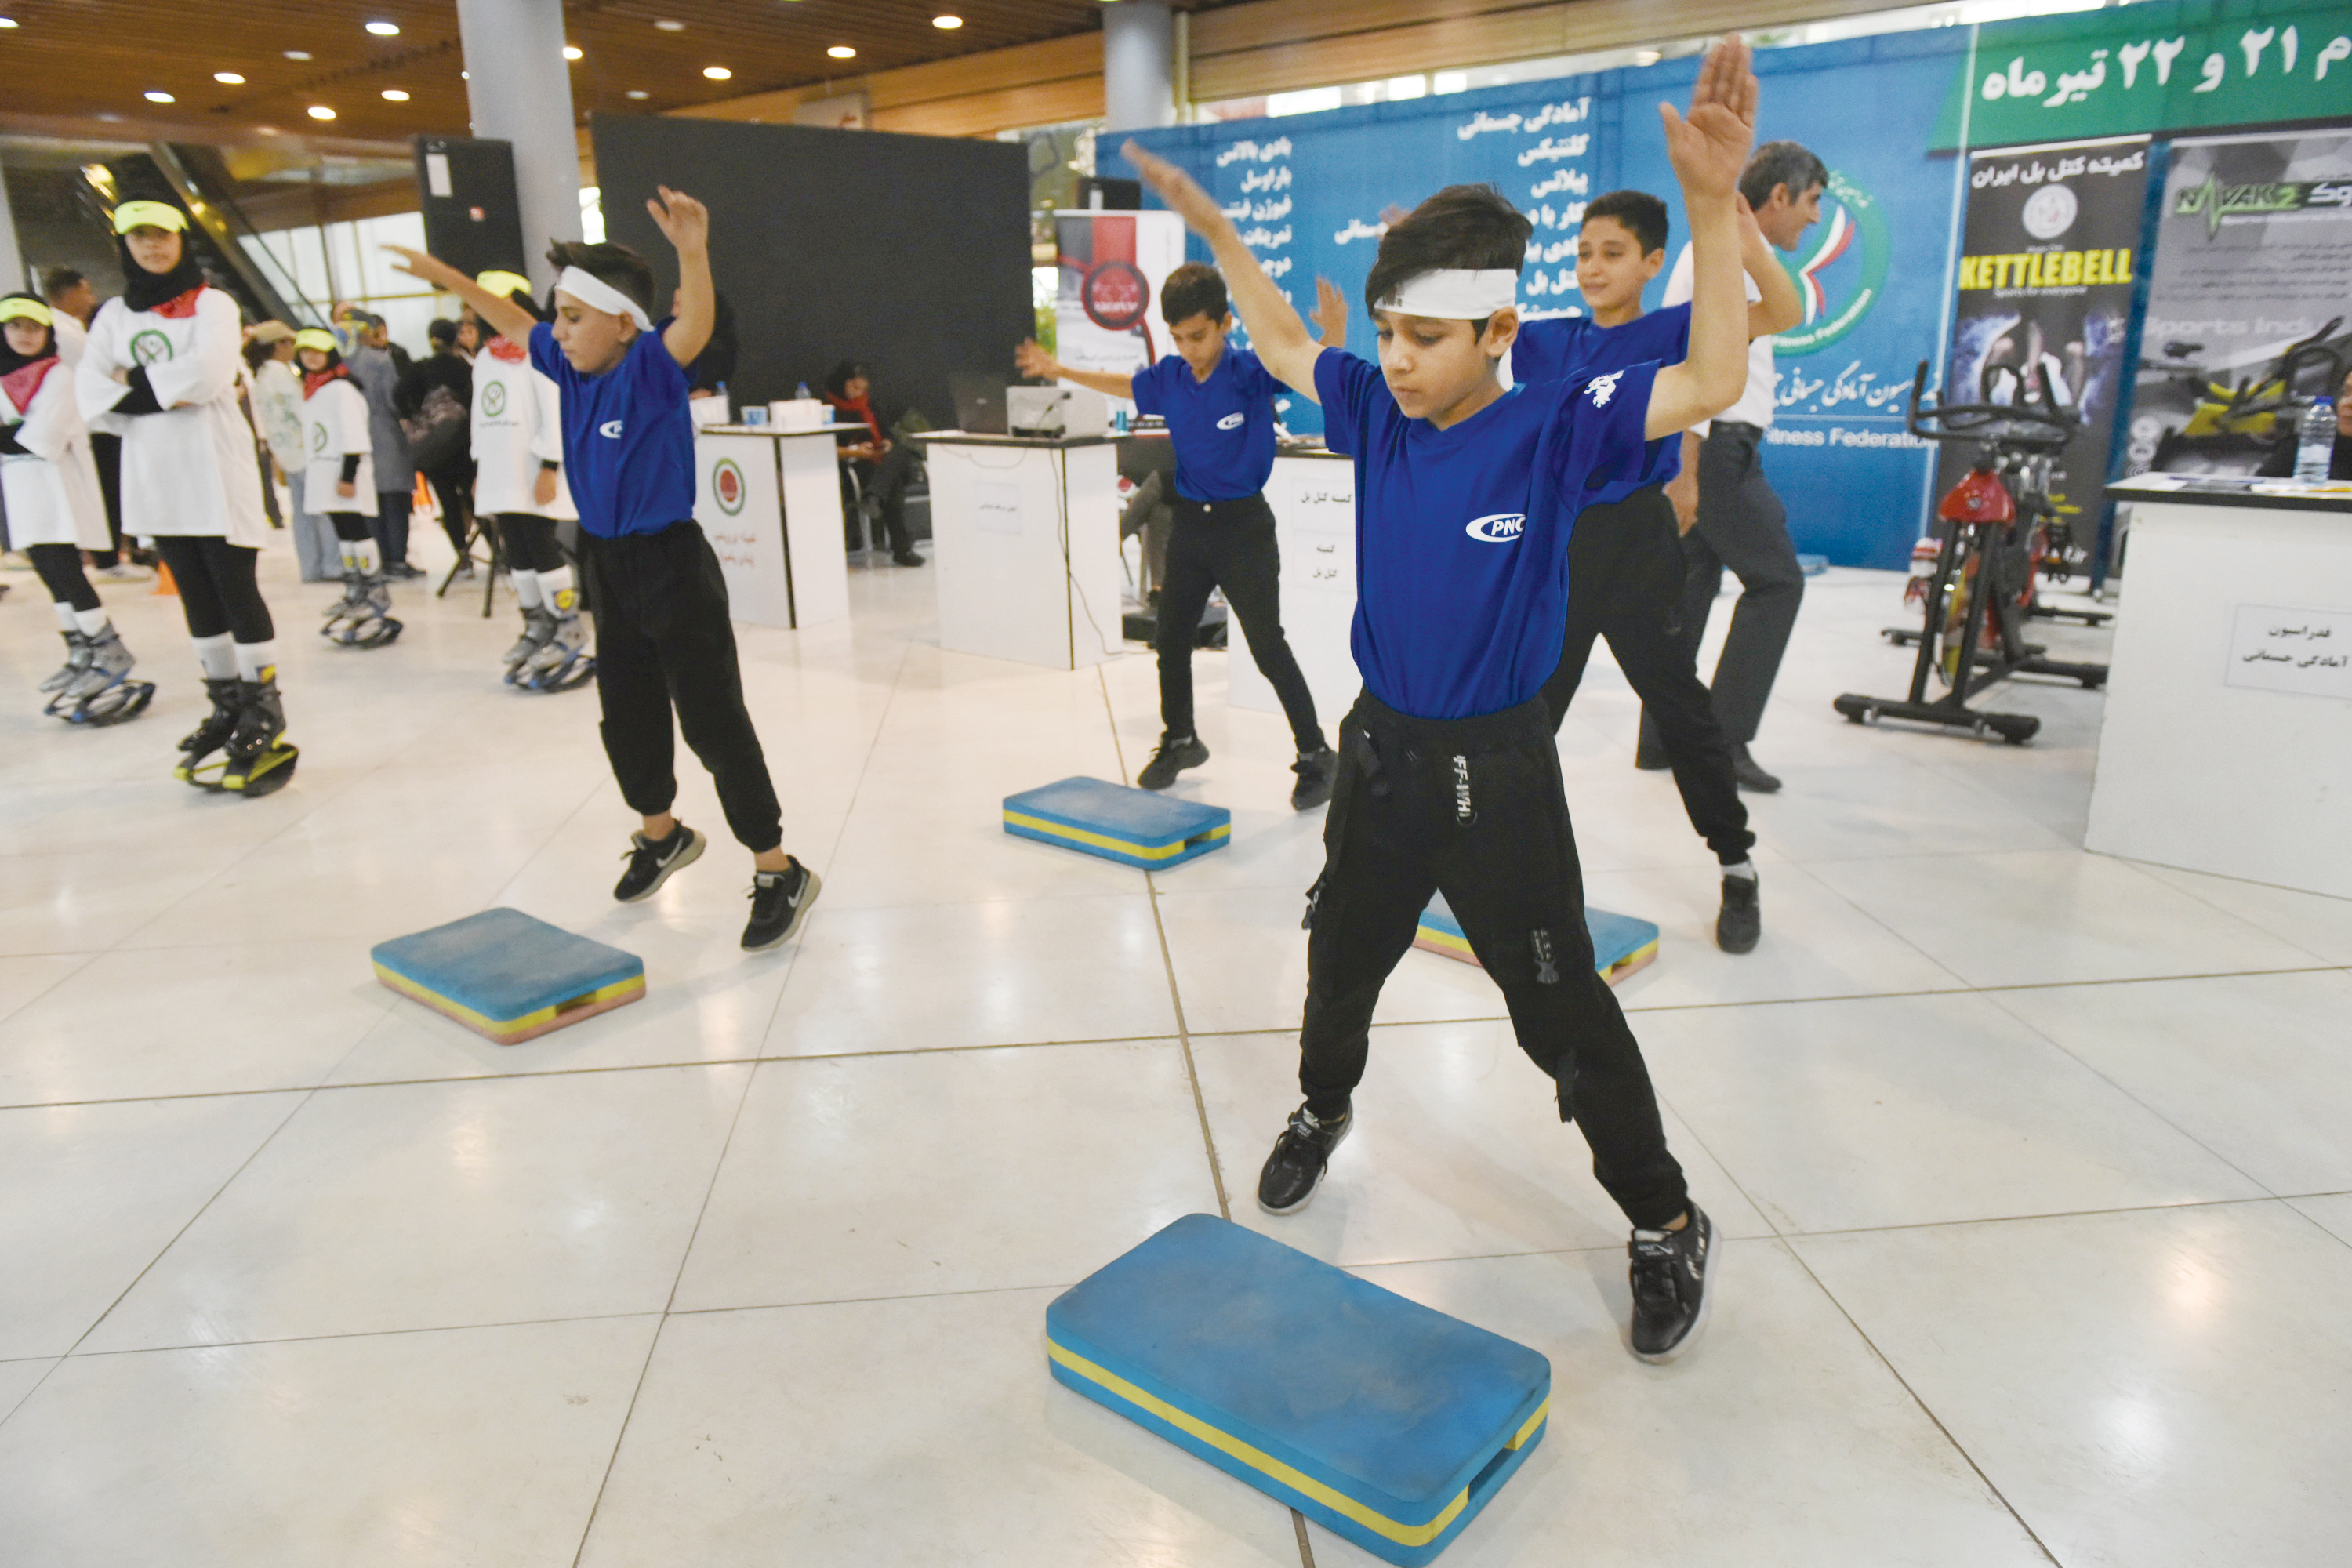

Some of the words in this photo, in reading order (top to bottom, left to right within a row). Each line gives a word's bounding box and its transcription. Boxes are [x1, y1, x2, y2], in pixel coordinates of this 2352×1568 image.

[1981, 57, 2046, 100] ماه
[2043, 49, 2109, 107] تیر
[2117, 35, 2186, 89] ۲۲
[2193, 52, 2226, 93] و
[1457, 111, 1523, 141] جسمانی
[1523, 96, 1592, 133] آمادگی
[1958, 248, 2132, 290] KETTLEBELL
